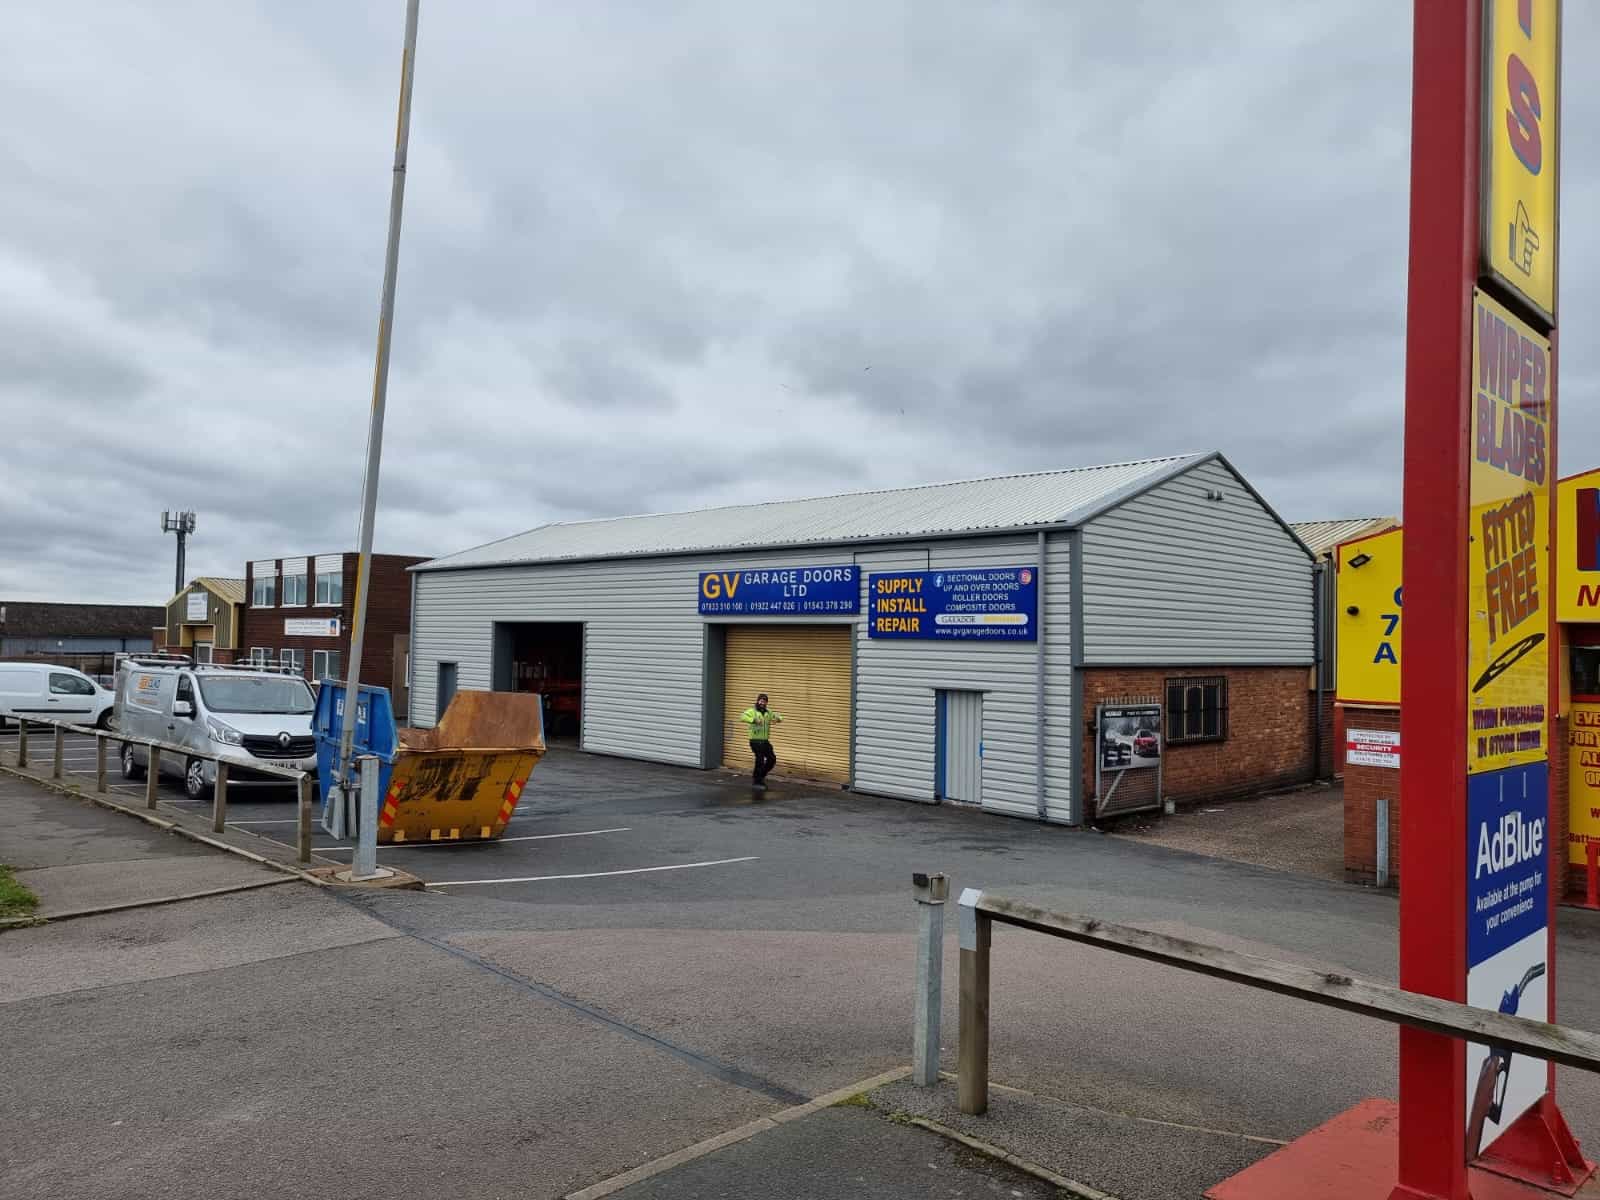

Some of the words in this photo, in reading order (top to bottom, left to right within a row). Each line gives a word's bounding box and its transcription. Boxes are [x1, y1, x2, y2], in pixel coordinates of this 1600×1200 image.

[1478, 304, 1546, 422] WIPER
[1477, 392, 1546, 485] BLADES
[1481, 491, 1536, 572] FITTED
[703, 573, 740, 599] GV
[744, 571, 797, 584] GARAGE
[803, 569, 851, 582] DOORS
[877, 578, 923, 593] SUPPLY
[943, 584, 952, 592] UP
[970, 583, 990, 591] OVER
[992, 582, 1019, 591] DOORS
[947, 573, 986, 582] SECTIONAL
[988, 572, 1015, 581] DOORS
[784, 584, 807, 597] LTD
[952, 593, 980, 602] ROLLER
[982, 593, 1008, 601] DOORS
[1486, 544, 1539, 645] FREE
[877, 598, 927, 612] INSTALL
[945, 603, 987, 612] COMPOSITE
[988, 603, 1016, 611] DOORS
[877, 618, 920, 632] REPAIR
[1380, 614, 1400, 636] 7
[1373, 642, 1398, 664] A
[1475, 812, 1543, 880] AdBlue
[1475, 888, 1502, 912] Available
[1503, 883, 1509, 900] at
[1509, 880, 1519, 898] the
[1519, 876, 1534, 896] pump
[1534, 871, 1543, 887] for
[1486, 913, 1500, 936] your
[1500, 897, 1534, 924] convenience
